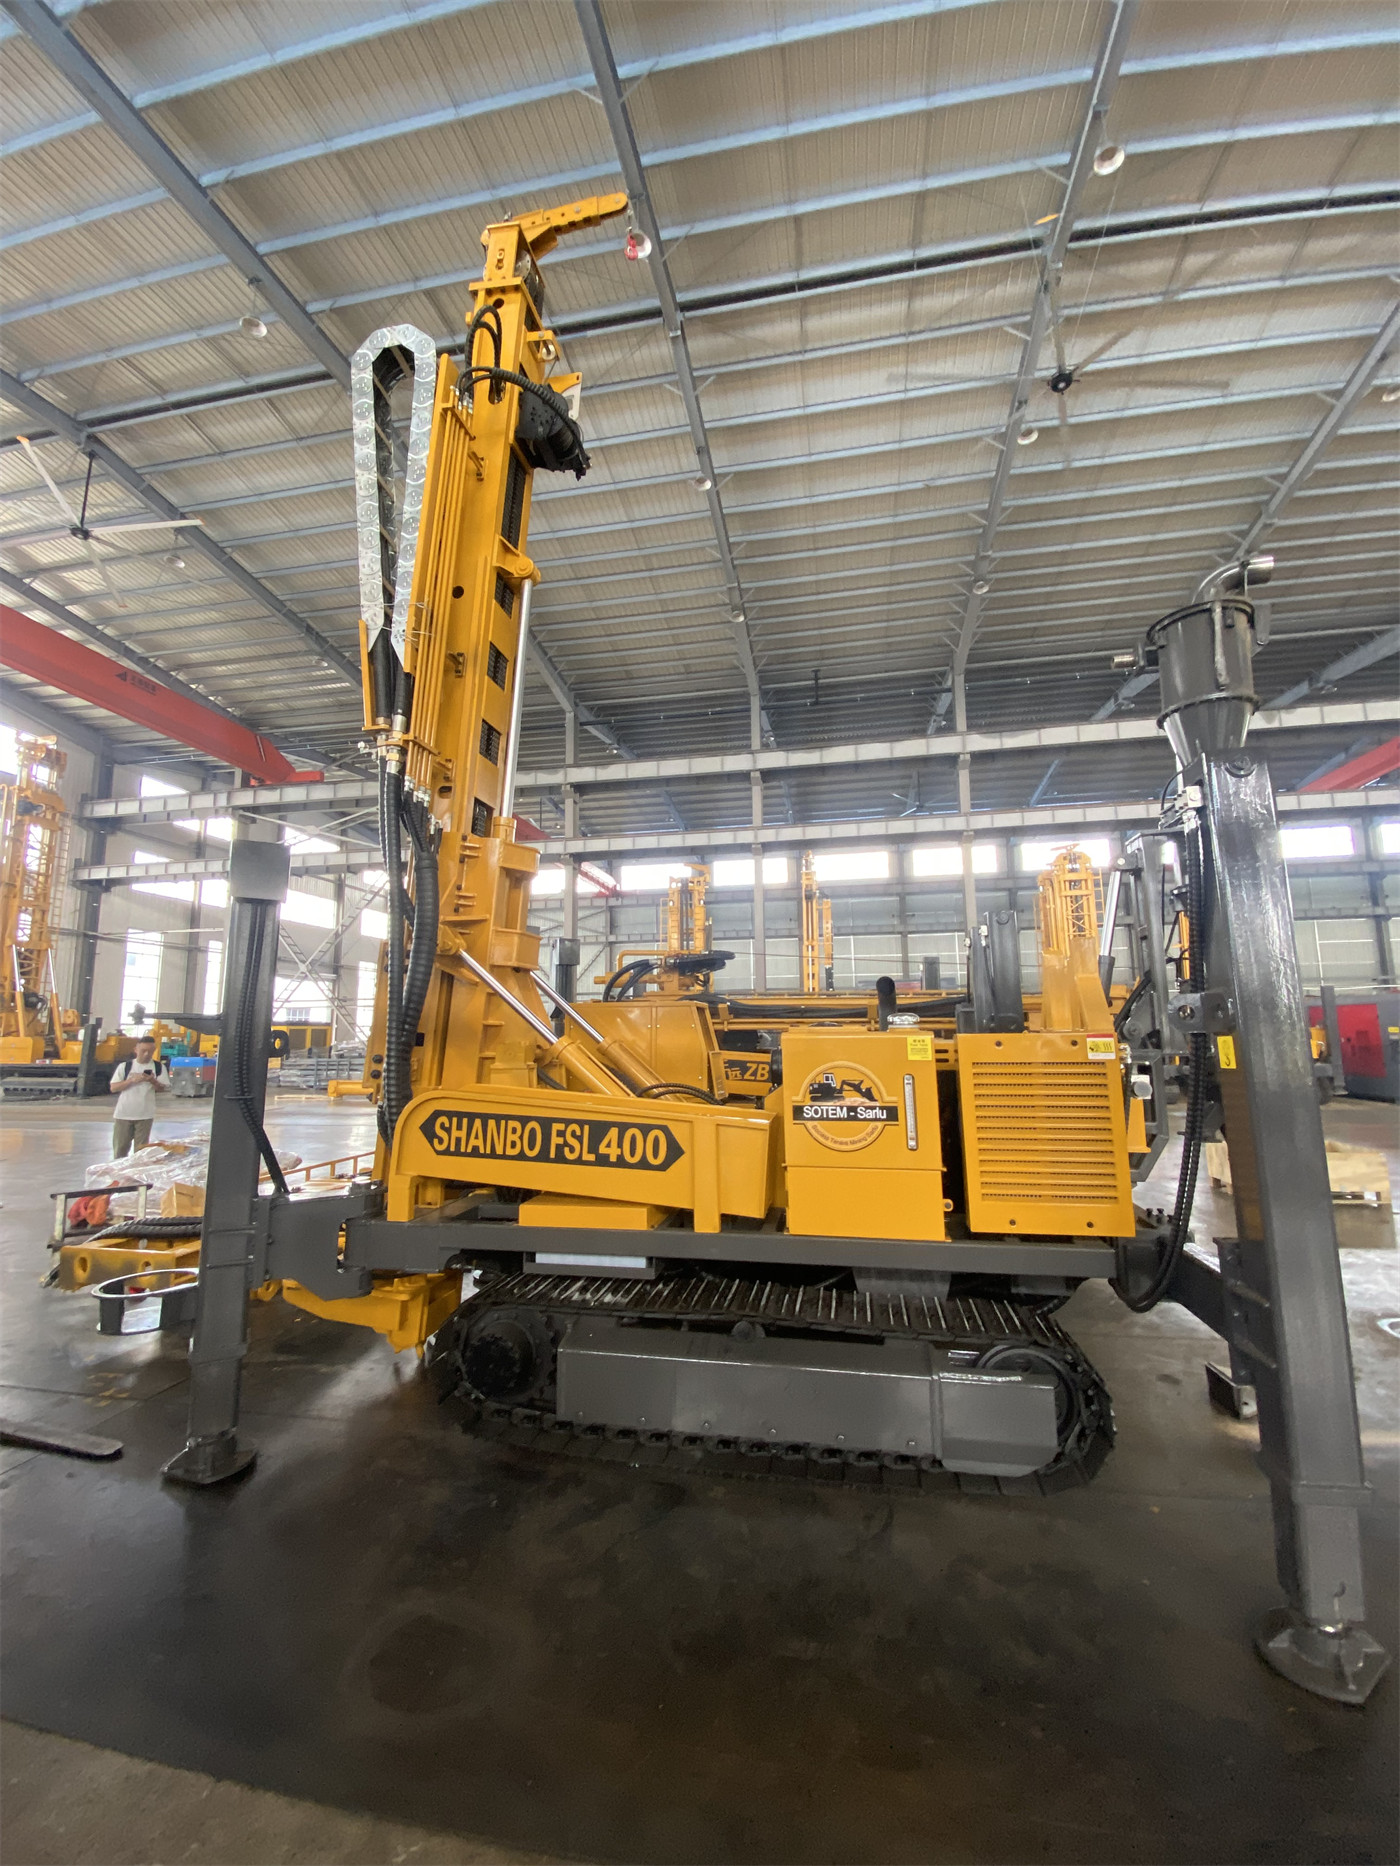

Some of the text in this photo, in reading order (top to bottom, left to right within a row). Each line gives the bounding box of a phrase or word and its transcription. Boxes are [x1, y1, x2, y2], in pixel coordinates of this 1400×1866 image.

[744, 1062, 769, 1080] ZB
[803, 1106, 847, 1118] SOTEM
[857, 1107, 887, 1119] Sarlu
[433, 1115, 542, 1157] SHANBO
